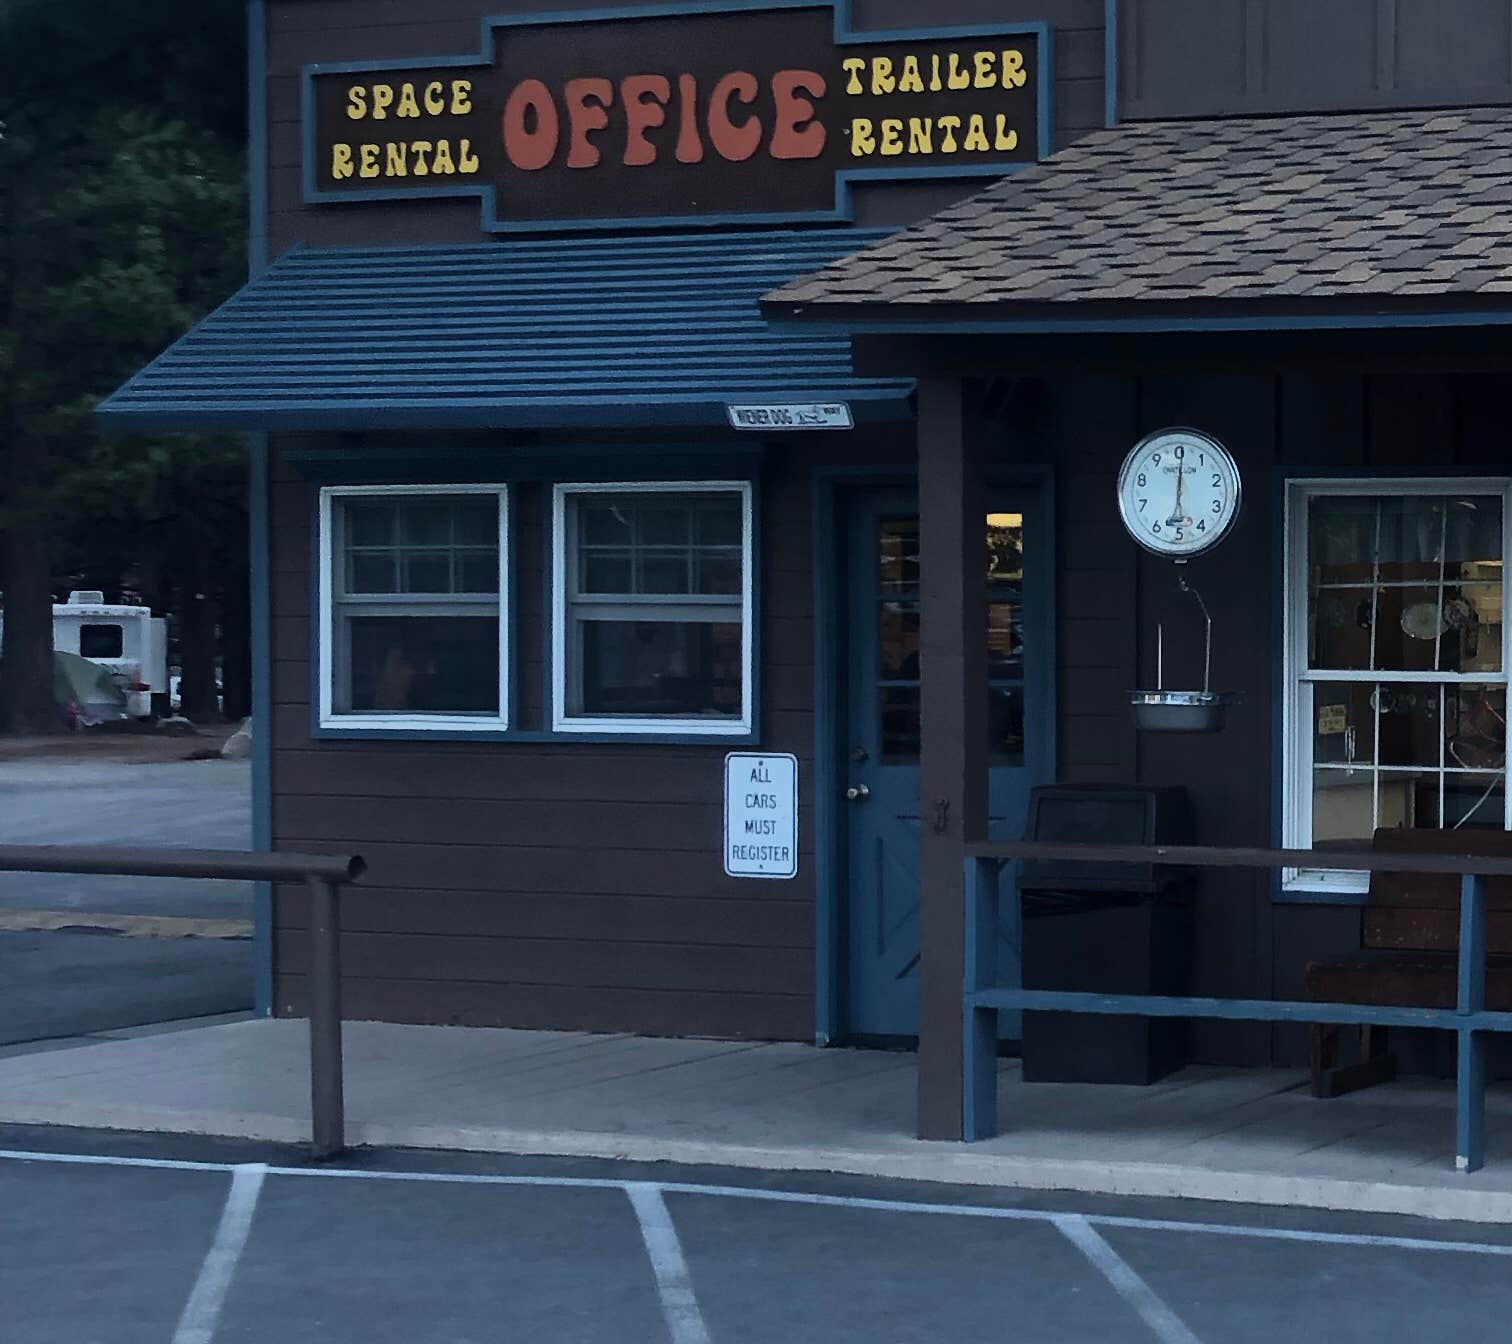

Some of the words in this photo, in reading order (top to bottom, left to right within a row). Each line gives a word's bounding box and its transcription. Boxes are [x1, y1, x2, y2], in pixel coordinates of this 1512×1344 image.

[843, 49, 1028, 96] TRAILER
[346, 79, 474, 121] SPACE
[502, 69, 828, 171] OFFICE
[849, 113, 1019, 158] RENTAL
[332, 138, 480, 181] RENTAL
[1152, 453, 1162, 467] 9
[1199, 453, 1205, 467] 1
[1137, 473, 1147, 488] 8
[1211, 473, 1222, 488] 2
[1138, 499, 1148, 513] 7
[1212, 499, 1221, 514] 3
[1152, 519, 1162, 533] 6
[1196, 519, 1207, 533] 4
[1175, 527, 1184, 541] 5
[750, 769, 772, 783] ALL
[745, 794, 777, 809] CARS
[745, 820, 776, 835] MUST
[732, 846, 790, 862] REGISTER
